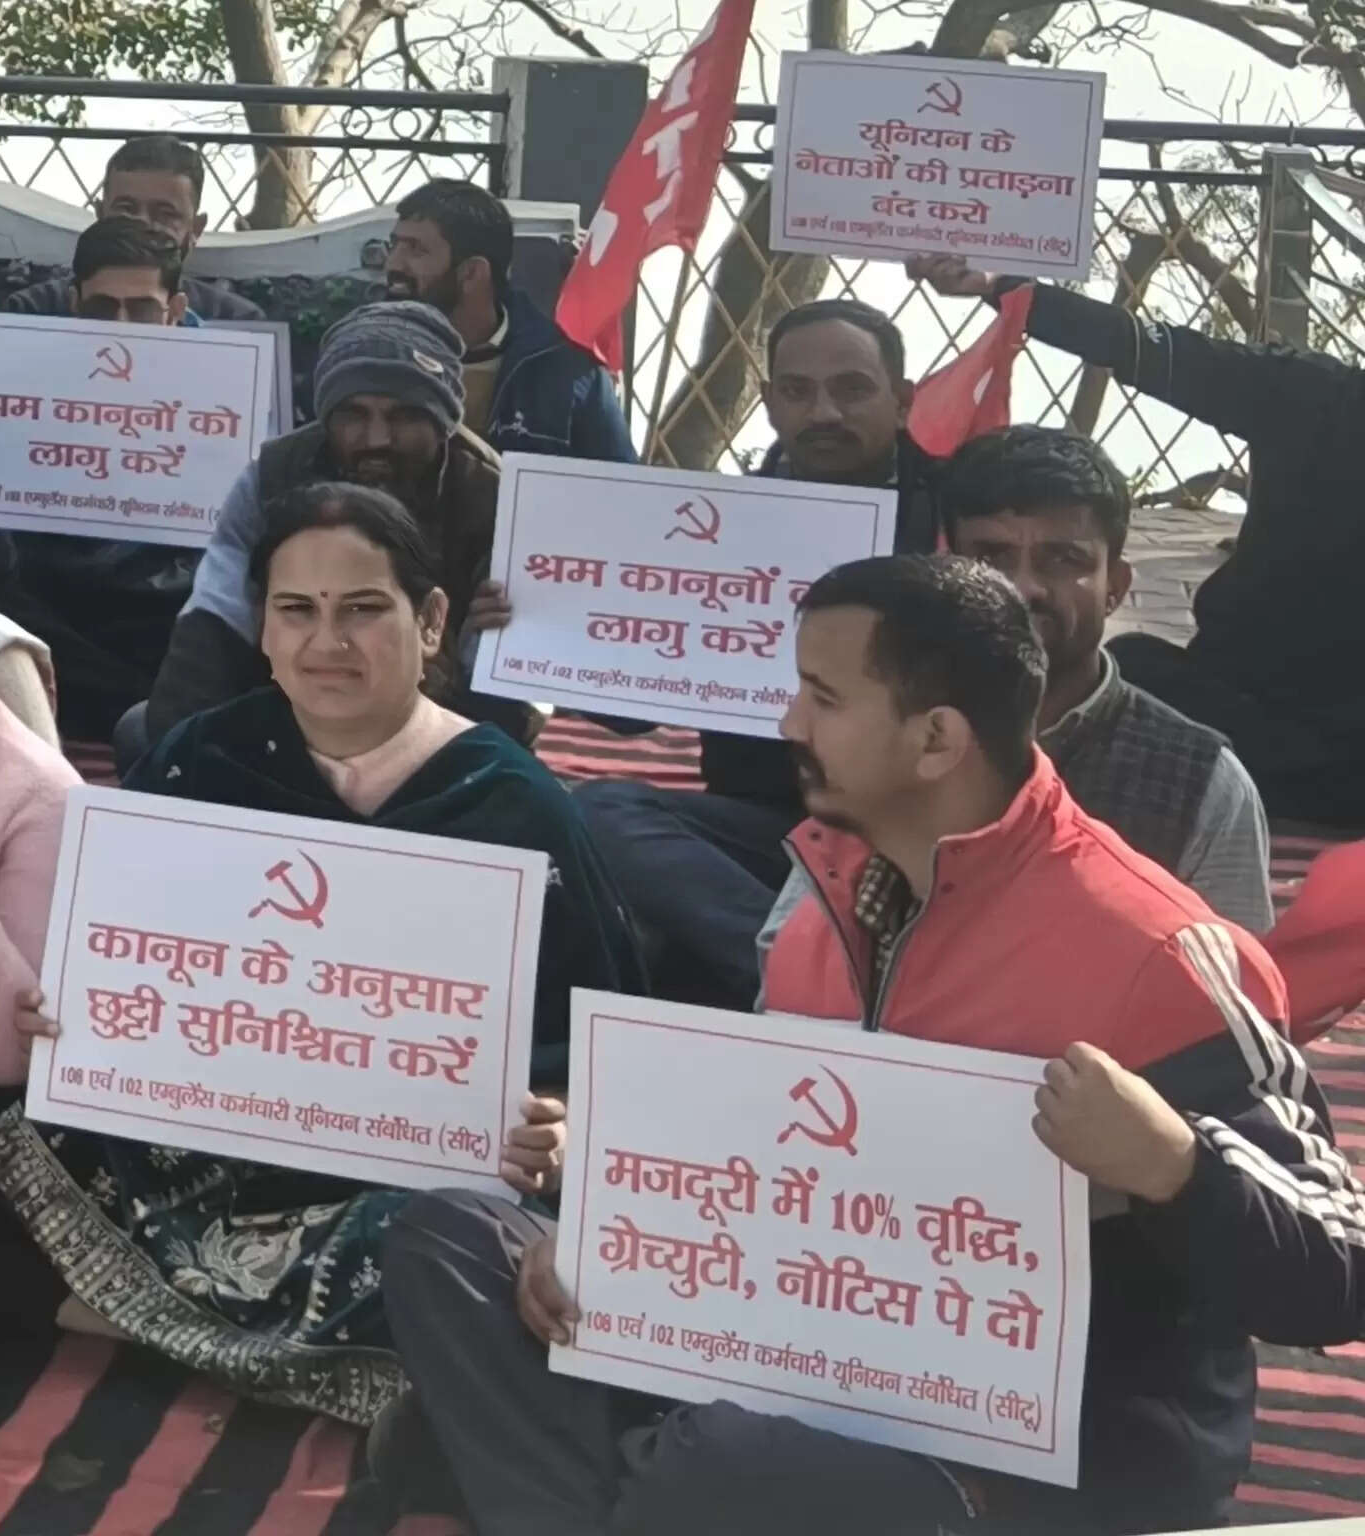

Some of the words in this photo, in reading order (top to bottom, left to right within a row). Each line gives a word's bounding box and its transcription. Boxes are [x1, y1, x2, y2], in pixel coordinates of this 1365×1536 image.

[859, 119, 973, 152] यूनियन
[980, 128, 1015, 153] के
[796, 148, 901, 180] नेताओं
[905, 158, 949, 185] की
[958, 168, 1075, 199] प्रताड़ना
[872, 190, 919, 218] बंद
[927, 198, 990, 224] करो
[52, 398, 182, 439] कानूनों
[188, 405, 242, 438] को
[28, 441, 111, 480] लागु
[121, 444, 186, 477] करें
[524, 554, 608, 588] श्रम
[619, 563, 782, 613] कानूनों
[587, 612, 690, 659] लागु
[701, 620, 785, 659] करें
[88, 922, 230, 988] कानून
[241, 939, 294, 985] के
[306, 960, 490, 1020] अनुसार
[86, 984, 166, 1041] छुट्टी
[177, 1000, 376, 1069] सुनिश्चित
[387, 1035, 479, 1085] करें
[89, 1067, 117, 1091] एवं
[149, 1080, 216, 1110] एम्बुलेंस
[219, 1092, 290, 1121] कर्मचारी
[294, 1102, 361, 1134] यूनियन
[438, 1122, 491, 1161] (सीटू)
[605, 1148, 760, 1227] मजदूरी
[771, 1166, 820, 1225] में
[831, 1190, 901, 1240] 10%
[915, 1196, 1039, 1273] वृद्धि,
[599, 1214, 757, 1300] ग्रेच्युटी,
[776, 1249, 923, 1327] नोटिस
[934, 1276, 974, 1337] पे
[987, 1289, 1043, 1351] दो
[617, 1312, 646, 1339] एवं
[681, 1328, 751, 1363] एम्बुलेंस
[754, 1342, 828, 1378] कर्मचारी
[833, 1356, 903, 1394] यूनियन
[986, 1384, 1042, 1434] (सीटू)
